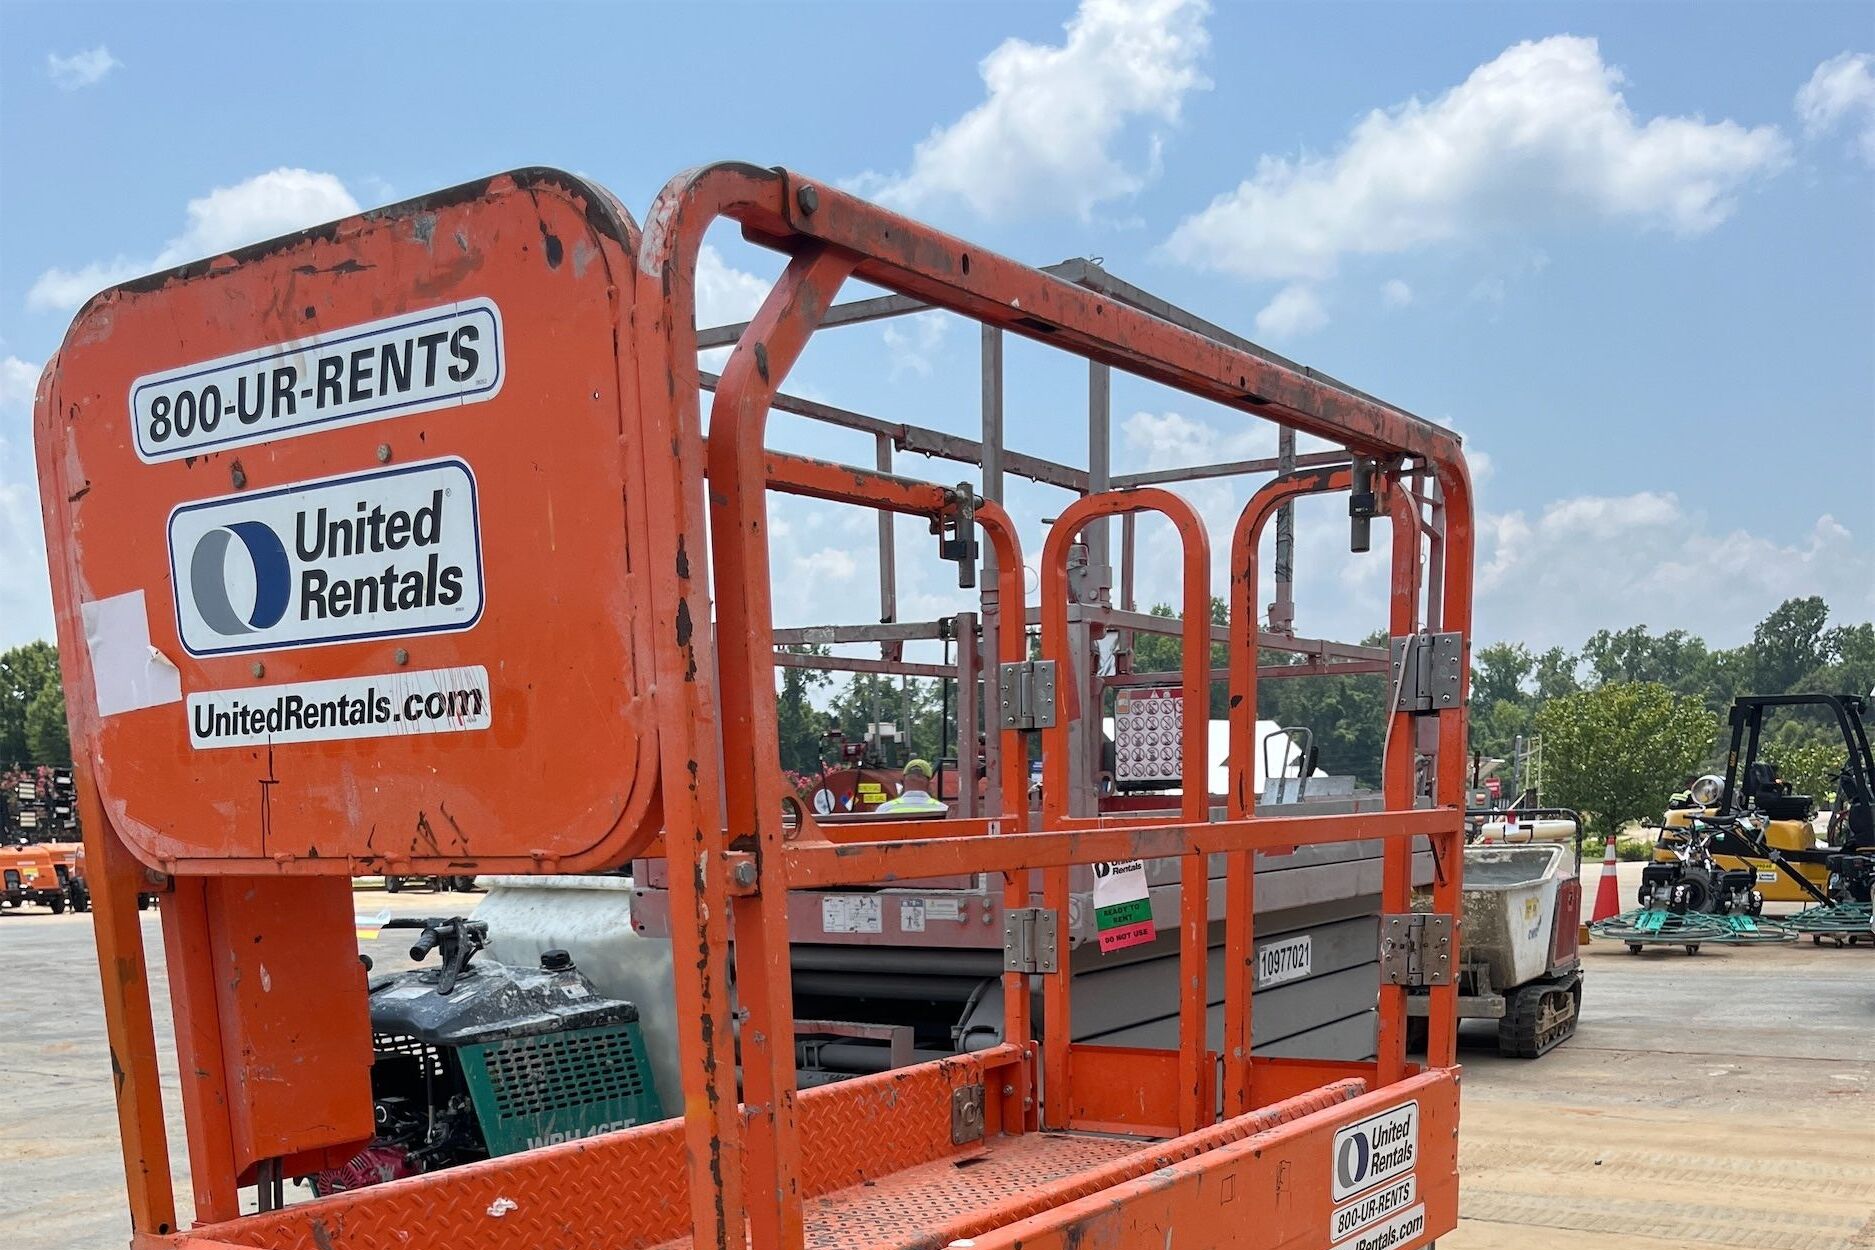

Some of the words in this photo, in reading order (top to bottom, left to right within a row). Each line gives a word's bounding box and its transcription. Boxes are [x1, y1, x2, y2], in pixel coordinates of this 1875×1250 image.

[149, 325, 480, 443] 800-UR-RENTS
[296, 489, 443, 562] United
[300, 553, 463, 621] Rentals
[195, 688, 482, 738] UnitedRentals.com
[1113, 862, 1142, 875] Rentals
[1104, 905, 1127, 916] READY
[1130, 903, 1140, 912] TO
[1113, 914, 1132, 923] RENT
[1116, 932, 1131, 941] NOT
[1133, 928, 1148, 937] USE
[1262, 942, 1309, 977] 10977021
[1372, 1114, 1411, 1150] United
[1371, 1140, 1413, 1177] Rentals
[1338, 1183, 1410, 1234] 800-UR-RENTS
